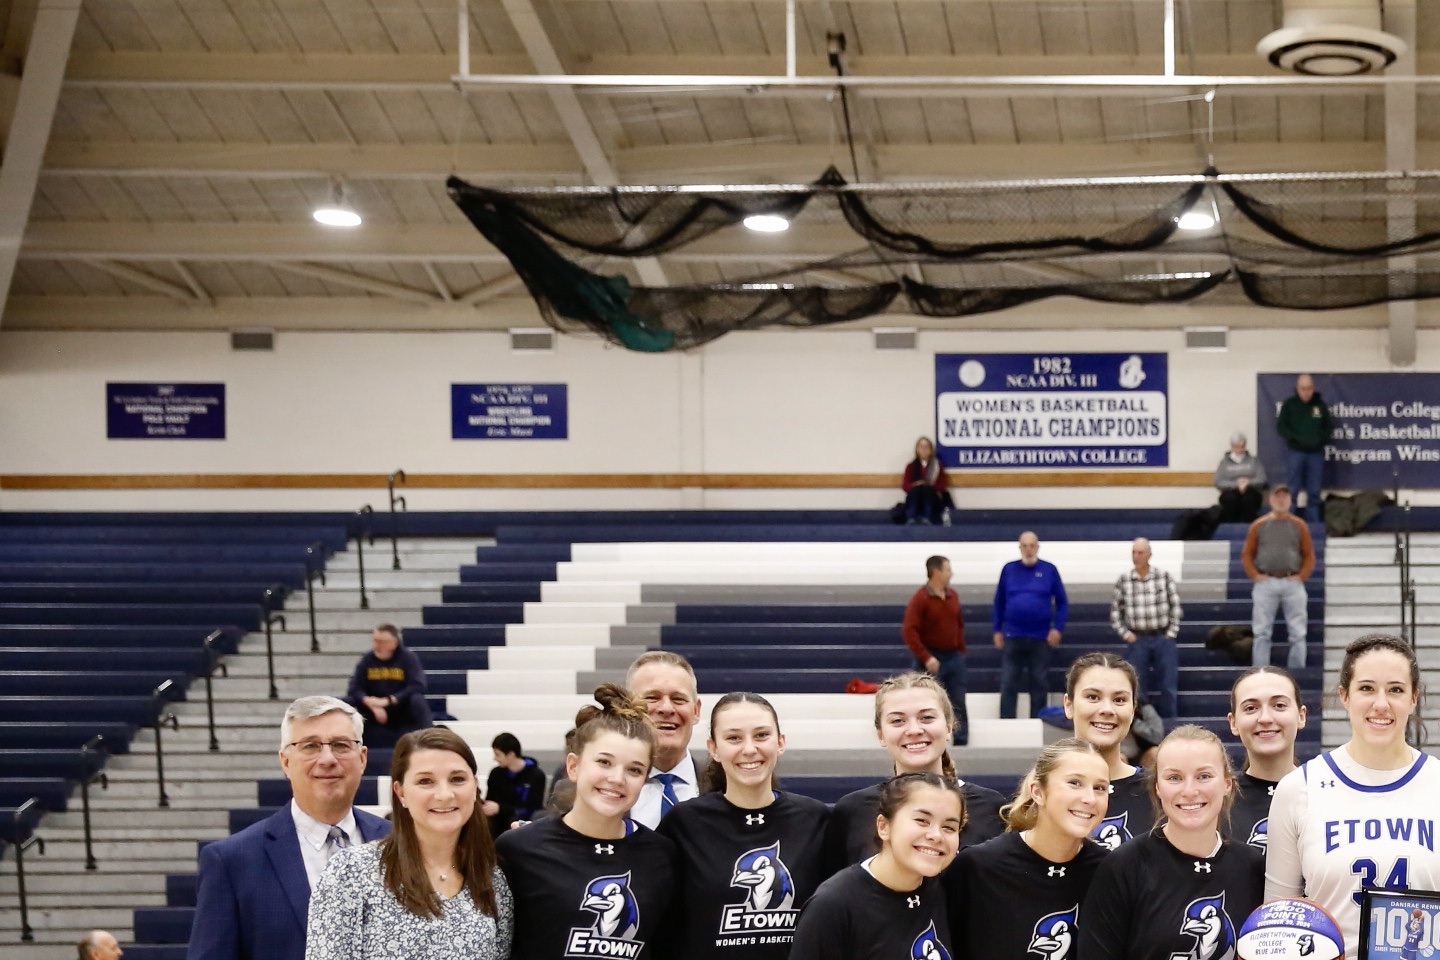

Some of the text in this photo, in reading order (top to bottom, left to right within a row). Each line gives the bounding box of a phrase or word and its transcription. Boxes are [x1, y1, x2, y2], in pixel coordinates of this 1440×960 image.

[1033, 357, 1072, 374] 1982
[1006, 374, 1098, 388] NCAA DIV. III
[957, 398, 1149, 413] WOMEN'S BASKETBALL
[944, 417, 1161, 438] NATIONAL CHAMPIONS
[959, 449, 1147, 464] ELIZABETHTOWN COLLEGE
[1324, 444, 1440, 464] Program Wins
[1326, 818, 1434, 853] ETOWN
[1390, 901, 1420, 909] DANIRAE
[724, 908, 797, 930] ETOWN
[1264, 911, 1306, 921] POINTS
[715, 935, 794, 947] WOMEN'S BASKET
[1250, 931, 1298, 941] ELIZABETHTOWN
[569, 931, 639, 958] ETOWN
